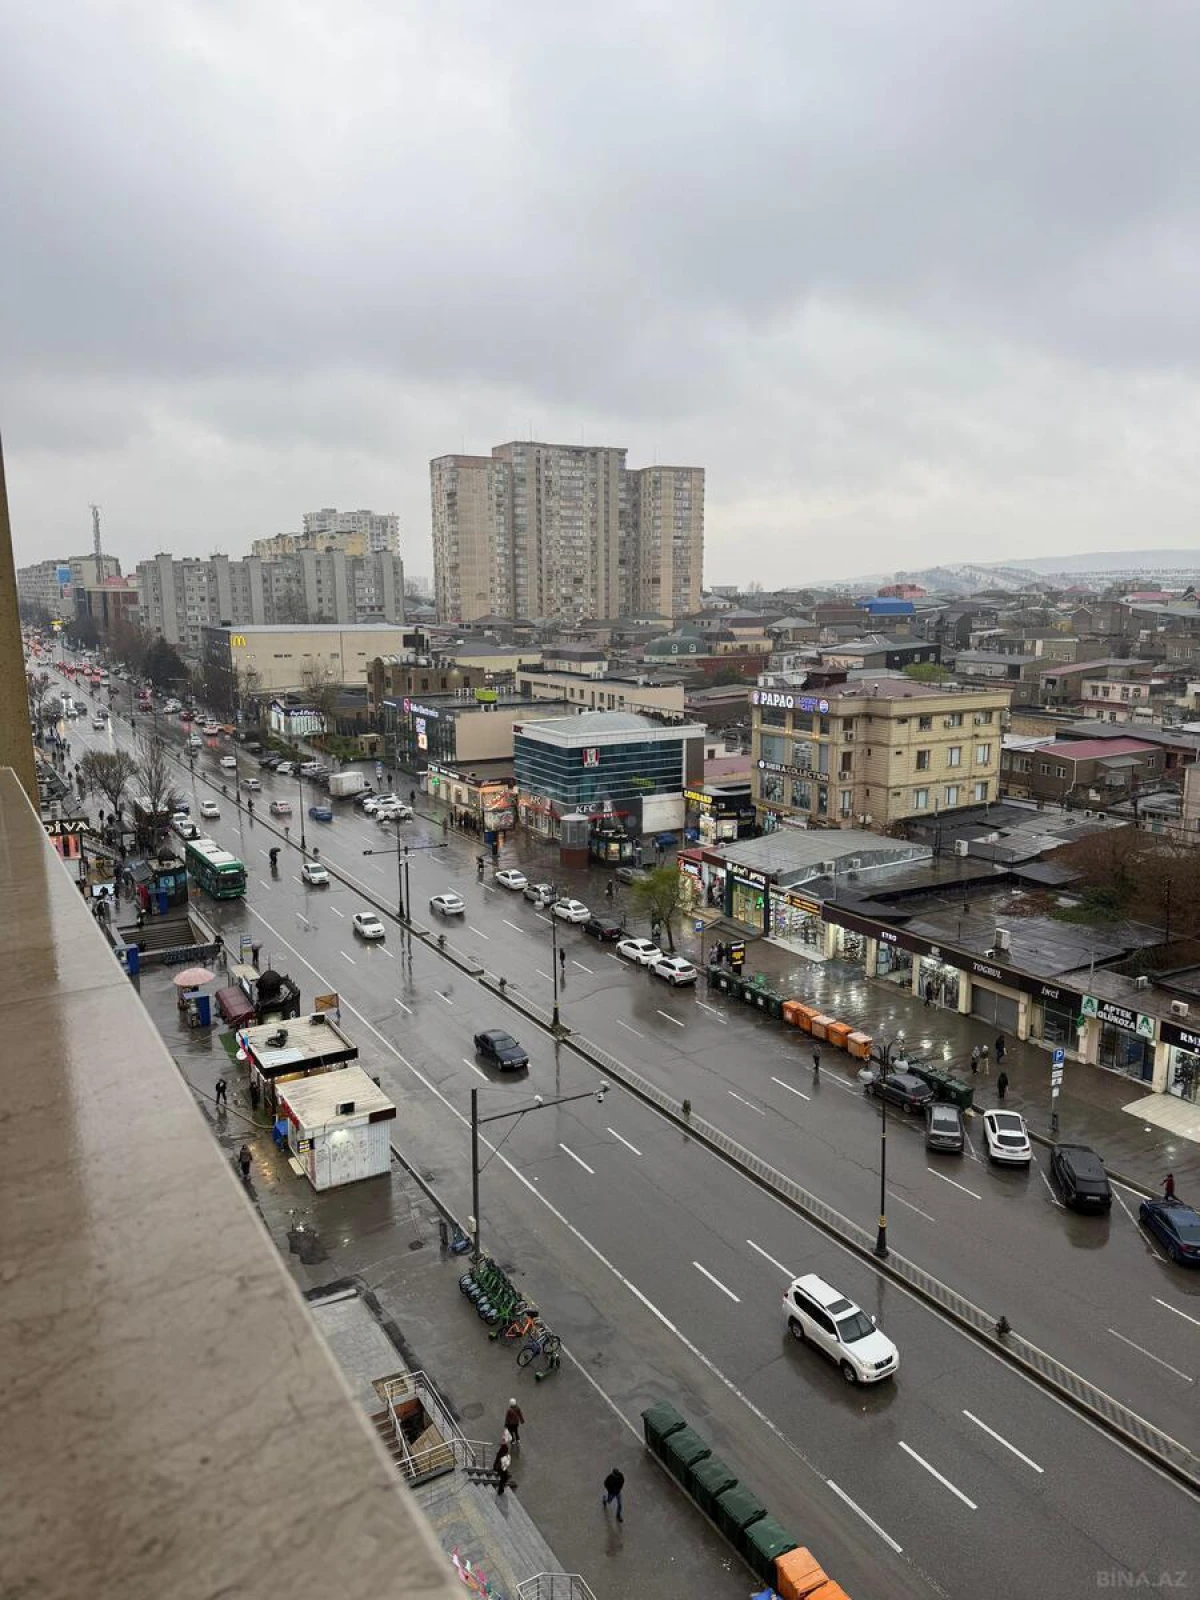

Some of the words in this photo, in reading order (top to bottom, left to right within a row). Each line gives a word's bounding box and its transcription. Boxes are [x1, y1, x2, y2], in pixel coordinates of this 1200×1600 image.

[760, 691, 794, 708] PAPAQ
[575, 803, 597, 814] KFC
[1103, 1003, 1133, 1021] APTEK
